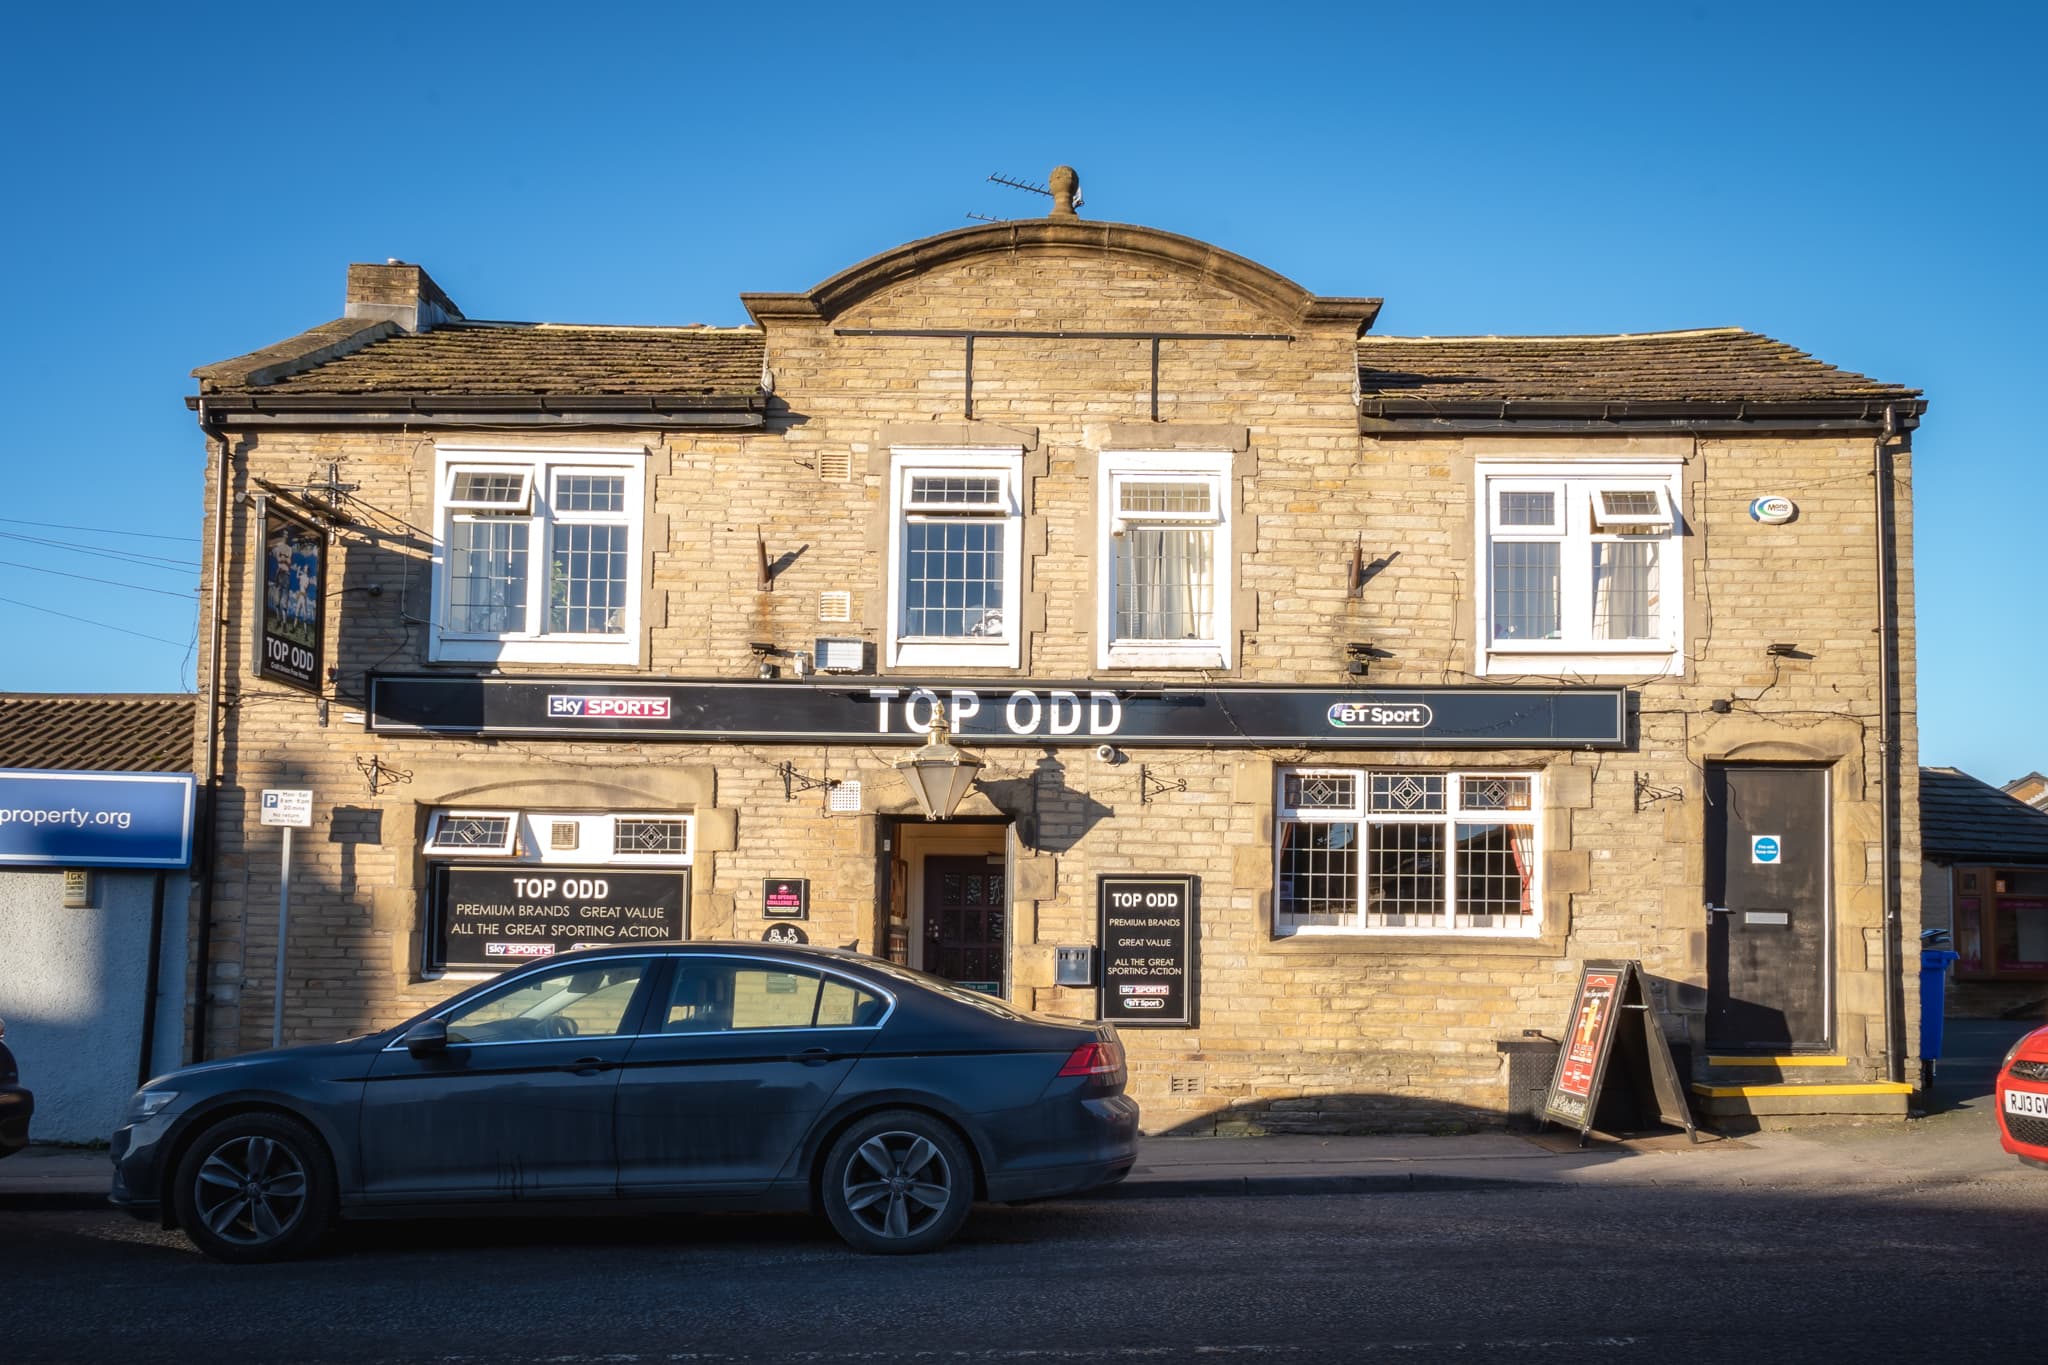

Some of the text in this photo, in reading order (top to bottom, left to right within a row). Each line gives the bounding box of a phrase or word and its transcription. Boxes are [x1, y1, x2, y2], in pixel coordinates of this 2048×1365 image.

[266, 636, 314, 671] TOP ODD
[553, 697, 665, 715] sky SPORTS
[869, 688, 1122, 735] TOP ODD
[1341, 707, 1420, 725] BT Sport
[0, 807, 131, 829] property.org
[513, 878, 609, 899] TOP ODD
[1112, 892, 1178, 907] TOP ODD
[456, 904, 665, 920] PREMIUM BRANDS GREAT VALUE
[1109, 918, 1181, 927] PREMIUM BRANDS
[450, 923, 670, 939] ALL THE GREAT SPORTING ACTION
[508, 944, 552, 956] SPORTS
[1118, 938, 1171, 947] GREAT VALUE
[1114, 958, 1175, 967] ALL THE GREAT
[1107, 967, 1182, 976] SPORTING ACTION
[1135, 986, 1168, 994] SPORTS
[1140, 1000, 1161, 1008] Sport
[2010, 1093, 2033, 1112] RJ13
